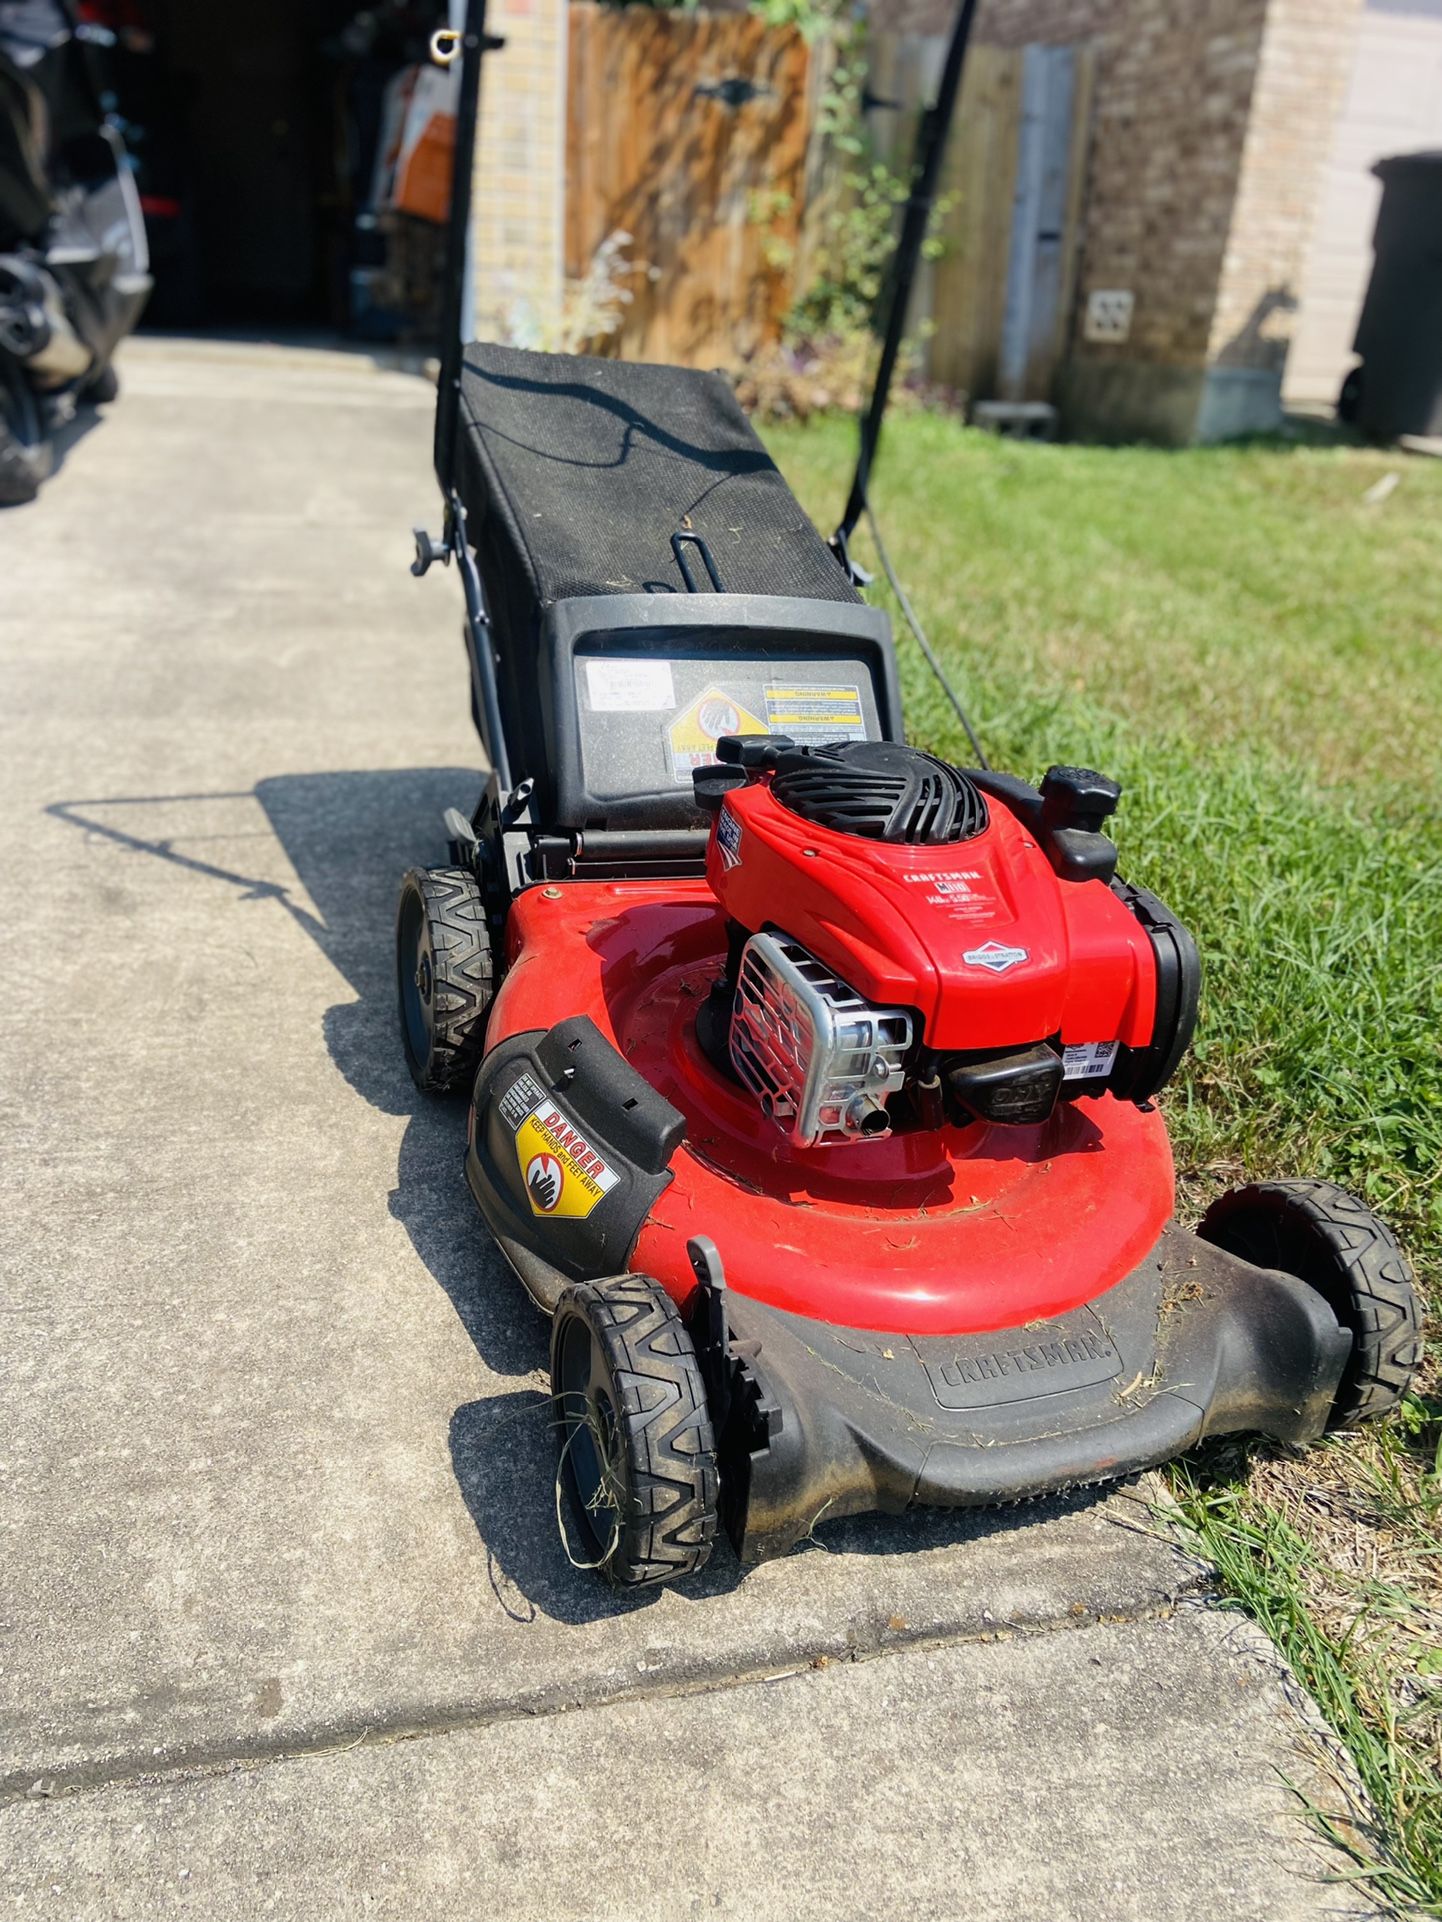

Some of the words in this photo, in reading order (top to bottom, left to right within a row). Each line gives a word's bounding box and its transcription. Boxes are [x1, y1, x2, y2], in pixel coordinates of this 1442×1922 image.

[903, 871, 981, 882] CRAFTSMAN
[530, 1117, 545, 1133] KEEP
[541, 1131, 560, 1153] HANDS
[557, 1151, 570, 1166] and
[567, 1160, 583, 1179] FEET
[580, 1175, 601, 1197] AWAY
[543, 1112, 605, 1179] DANGER
[940, 1337, 1105, 1387] CRAFTSMAN
